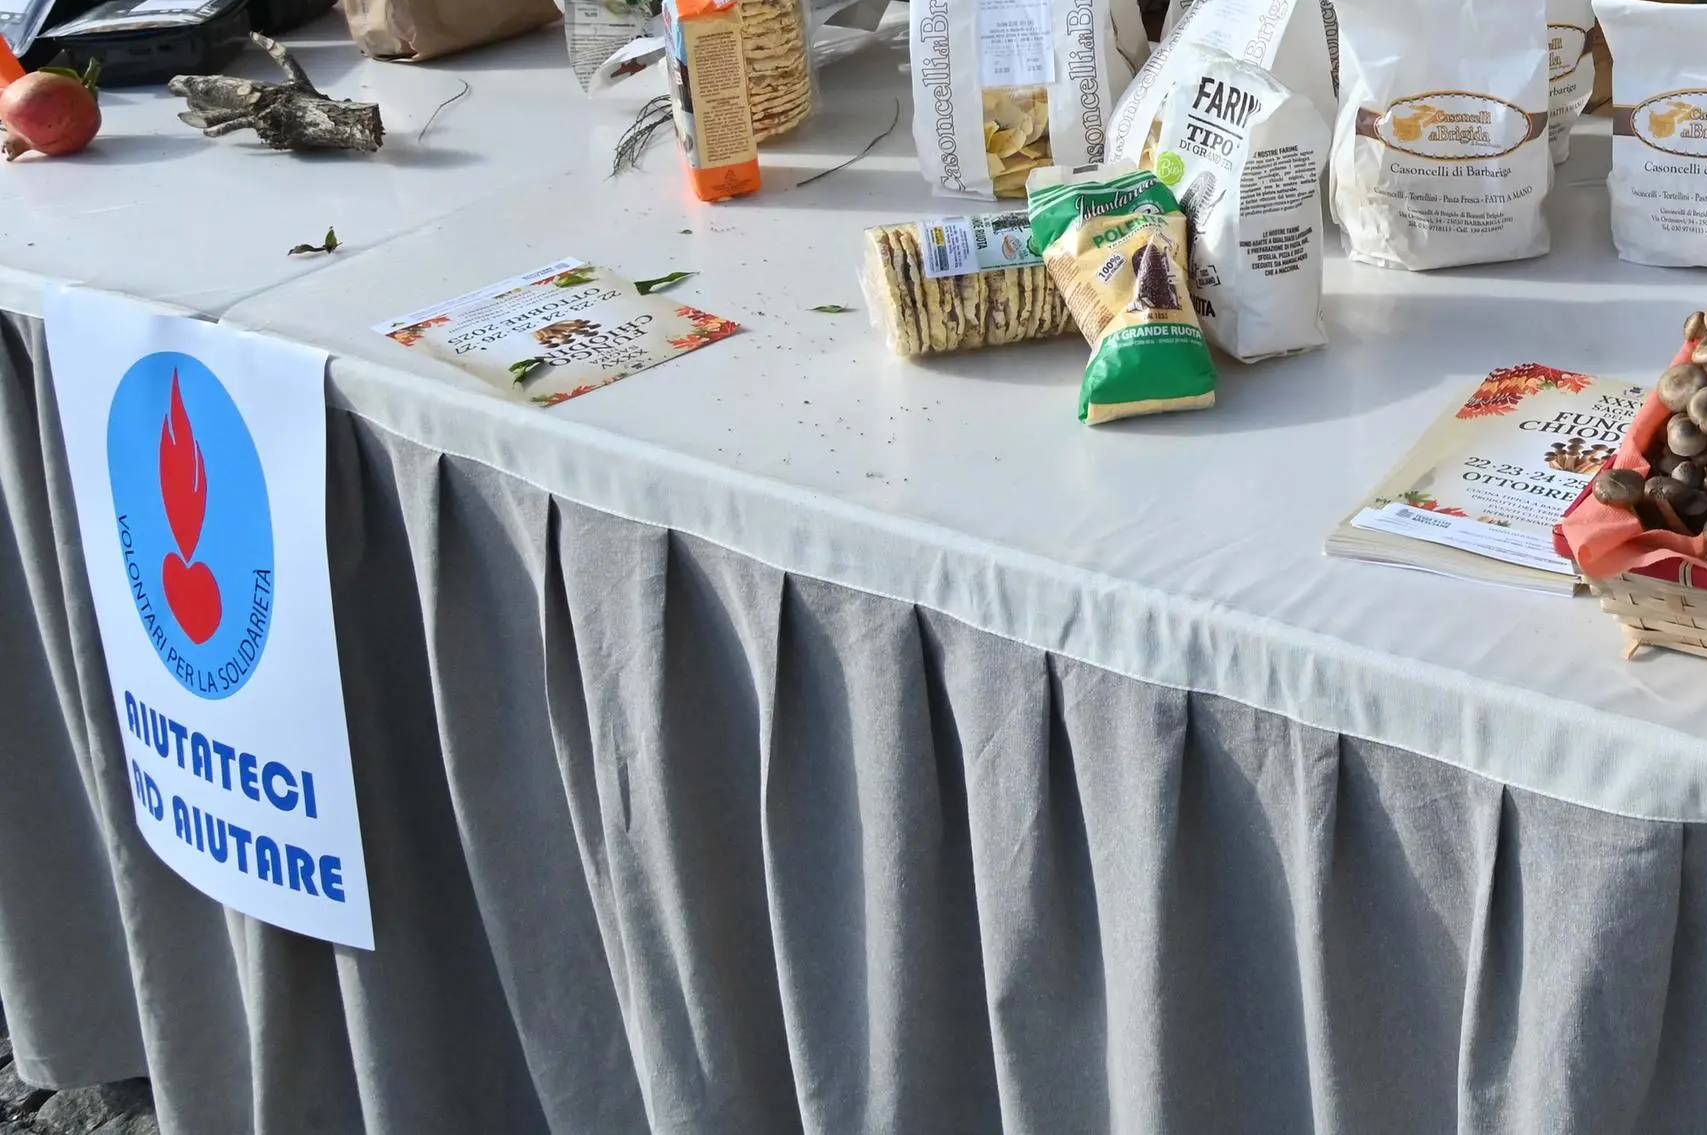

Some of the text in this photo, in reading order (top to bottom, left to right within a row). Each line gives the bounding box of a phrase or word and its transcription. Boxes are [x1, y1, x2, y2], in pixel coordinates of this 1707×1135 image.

[1069, 54, 1106, 164] asoncelli
[1436, 110, 1491, 124] Casoncelli
[1187, 123, 1235, 156] TIPO
[1436, 126, 1491, 144] Brigida
[1257, 145, 1298, 158] NOSTRE FARINE
[1390, 163, 1512, 179] Casoncelli di Barbariga
[1644, 161, 1700, 175] Casoncelli
[1408, 185, 1533, 204] Tortellini Pasta Fresca FATTI A MANO
[1662, 190, 1690, 201] Tortellini
[1652, 214, 1660, 222] Via
[1251, 244, 1283, 254] PREPARAZIONE
[1098, 253, 1121, 279] 100%
[499, 287, 601, 328] OTTOBRE
[448, 322, 499, 345] 2025
[544, 314, 654, 361] CHIODIN
[1122, 325, 1169, 341] GRANDE
[1170, 325, 1202, 339] RUOTA
[550, 328, 648, 367] FUNGO
[1592, 404, 1636, 417] SAGR
[1519, 420, 1621, 443] CHIOD
[1462, 472, 1578, 502] OTTOBRE
[1466, 488, 1500, 498] CUCINA
[1503, 495, 1530, 505] TIPICA
[1472, 494, 1511, 507] PRODOTTI
[118, 514, 272, 693] VOLONTARI PER LA SOLIDARIETÀ
[124, 689, 318, 820] AIUTATECI
[131, 758, 346, 904] AD AIUTARE
